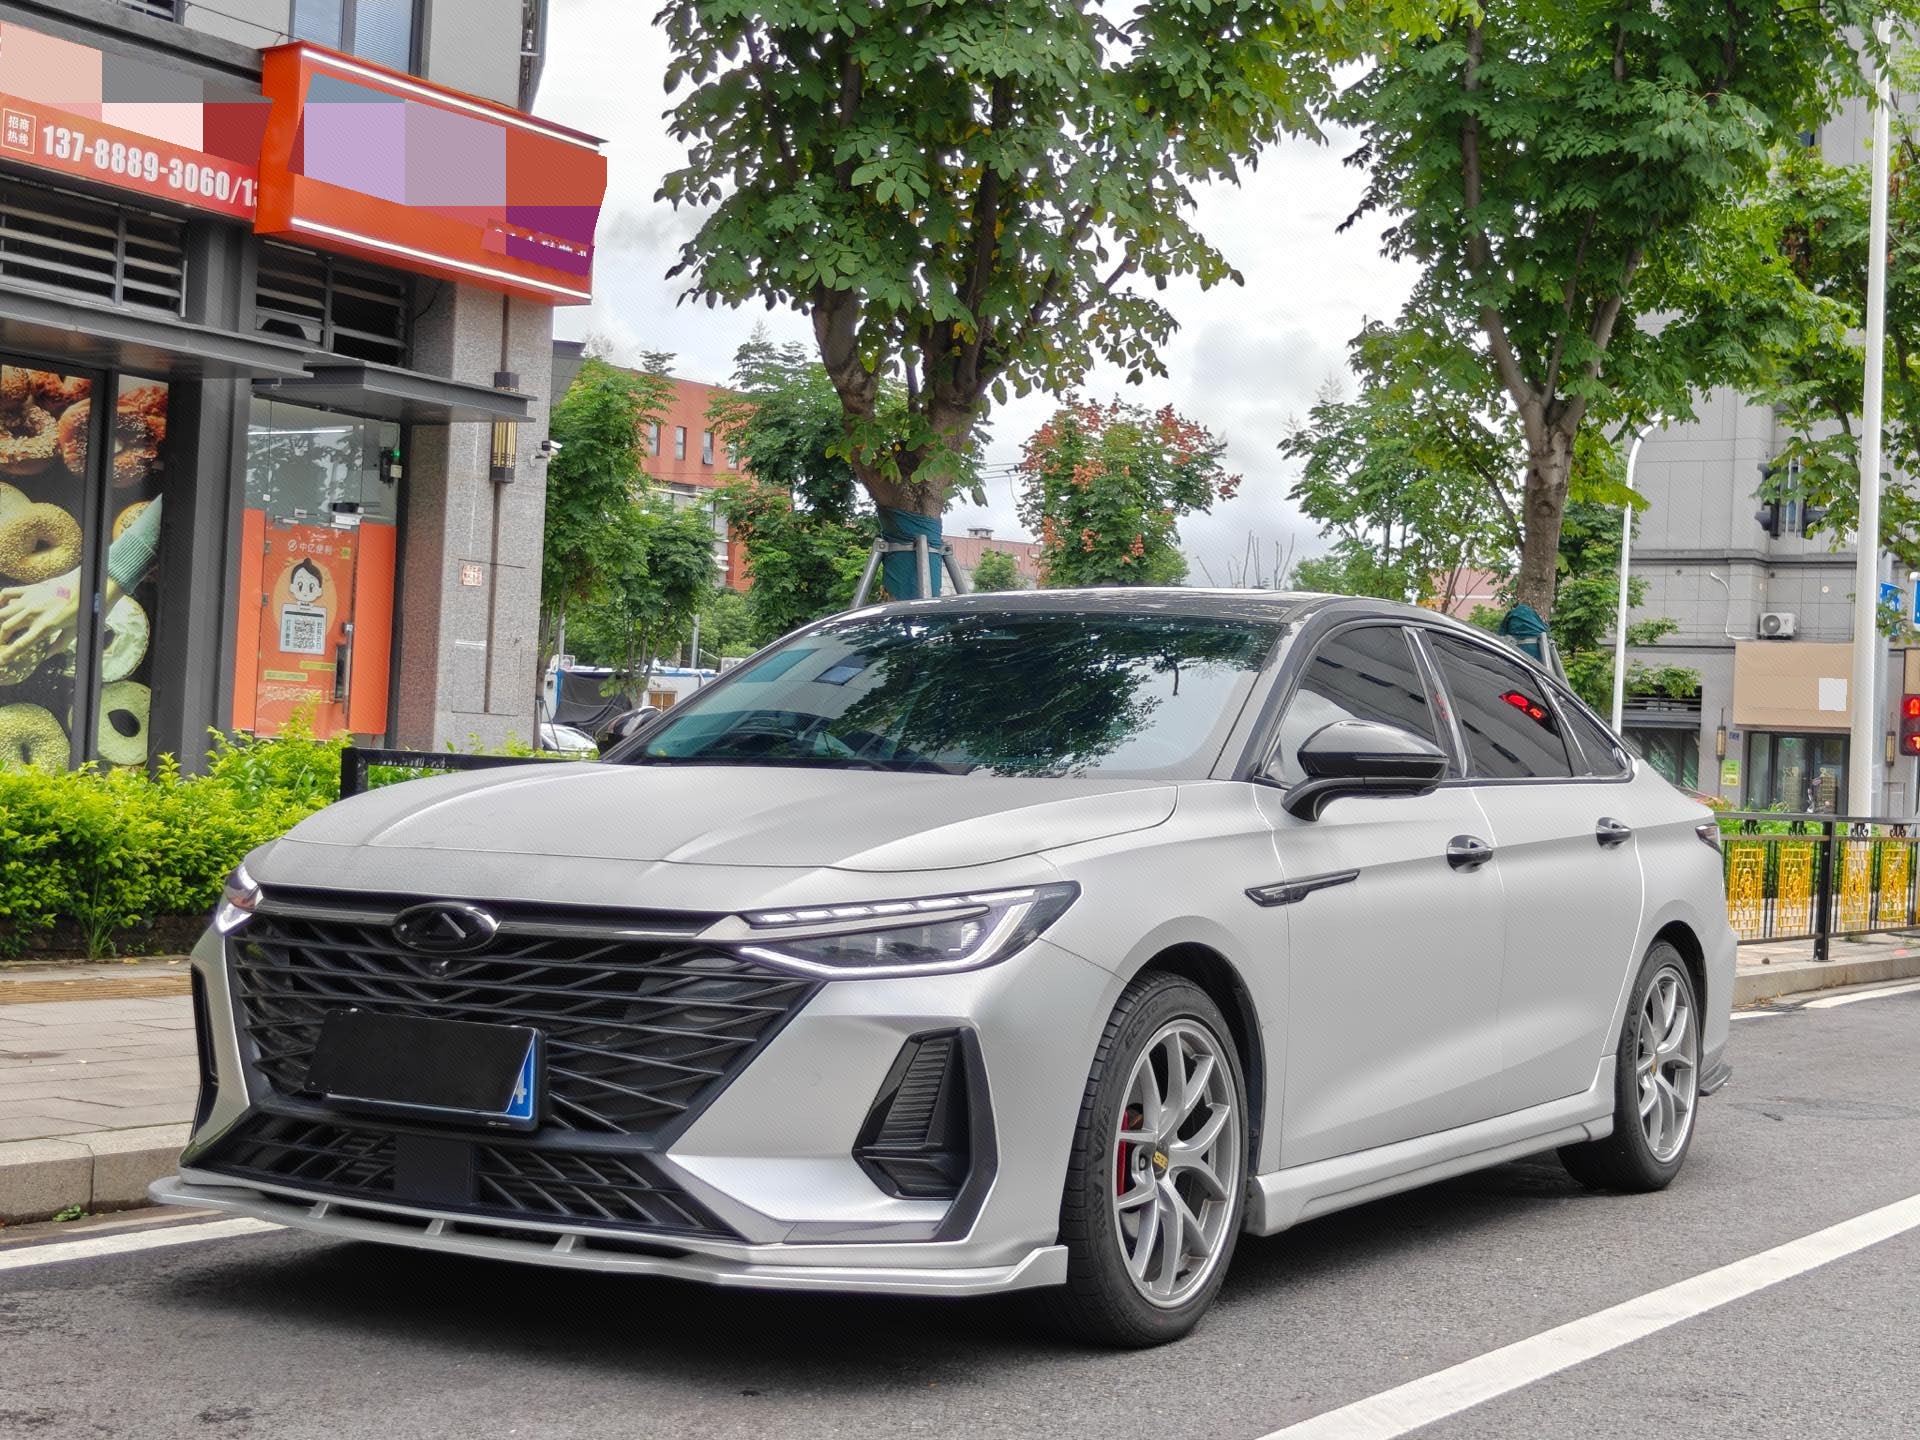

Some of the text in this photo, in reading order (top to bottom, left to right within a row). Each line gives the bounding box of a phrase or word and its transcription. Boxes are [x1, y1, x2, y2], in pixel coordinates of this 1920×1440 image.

[8, 115, 30, 132] 招商
[8, 129, 29, 147] 热线
[43, 125, 258, 207] 137-8889-3060/1
